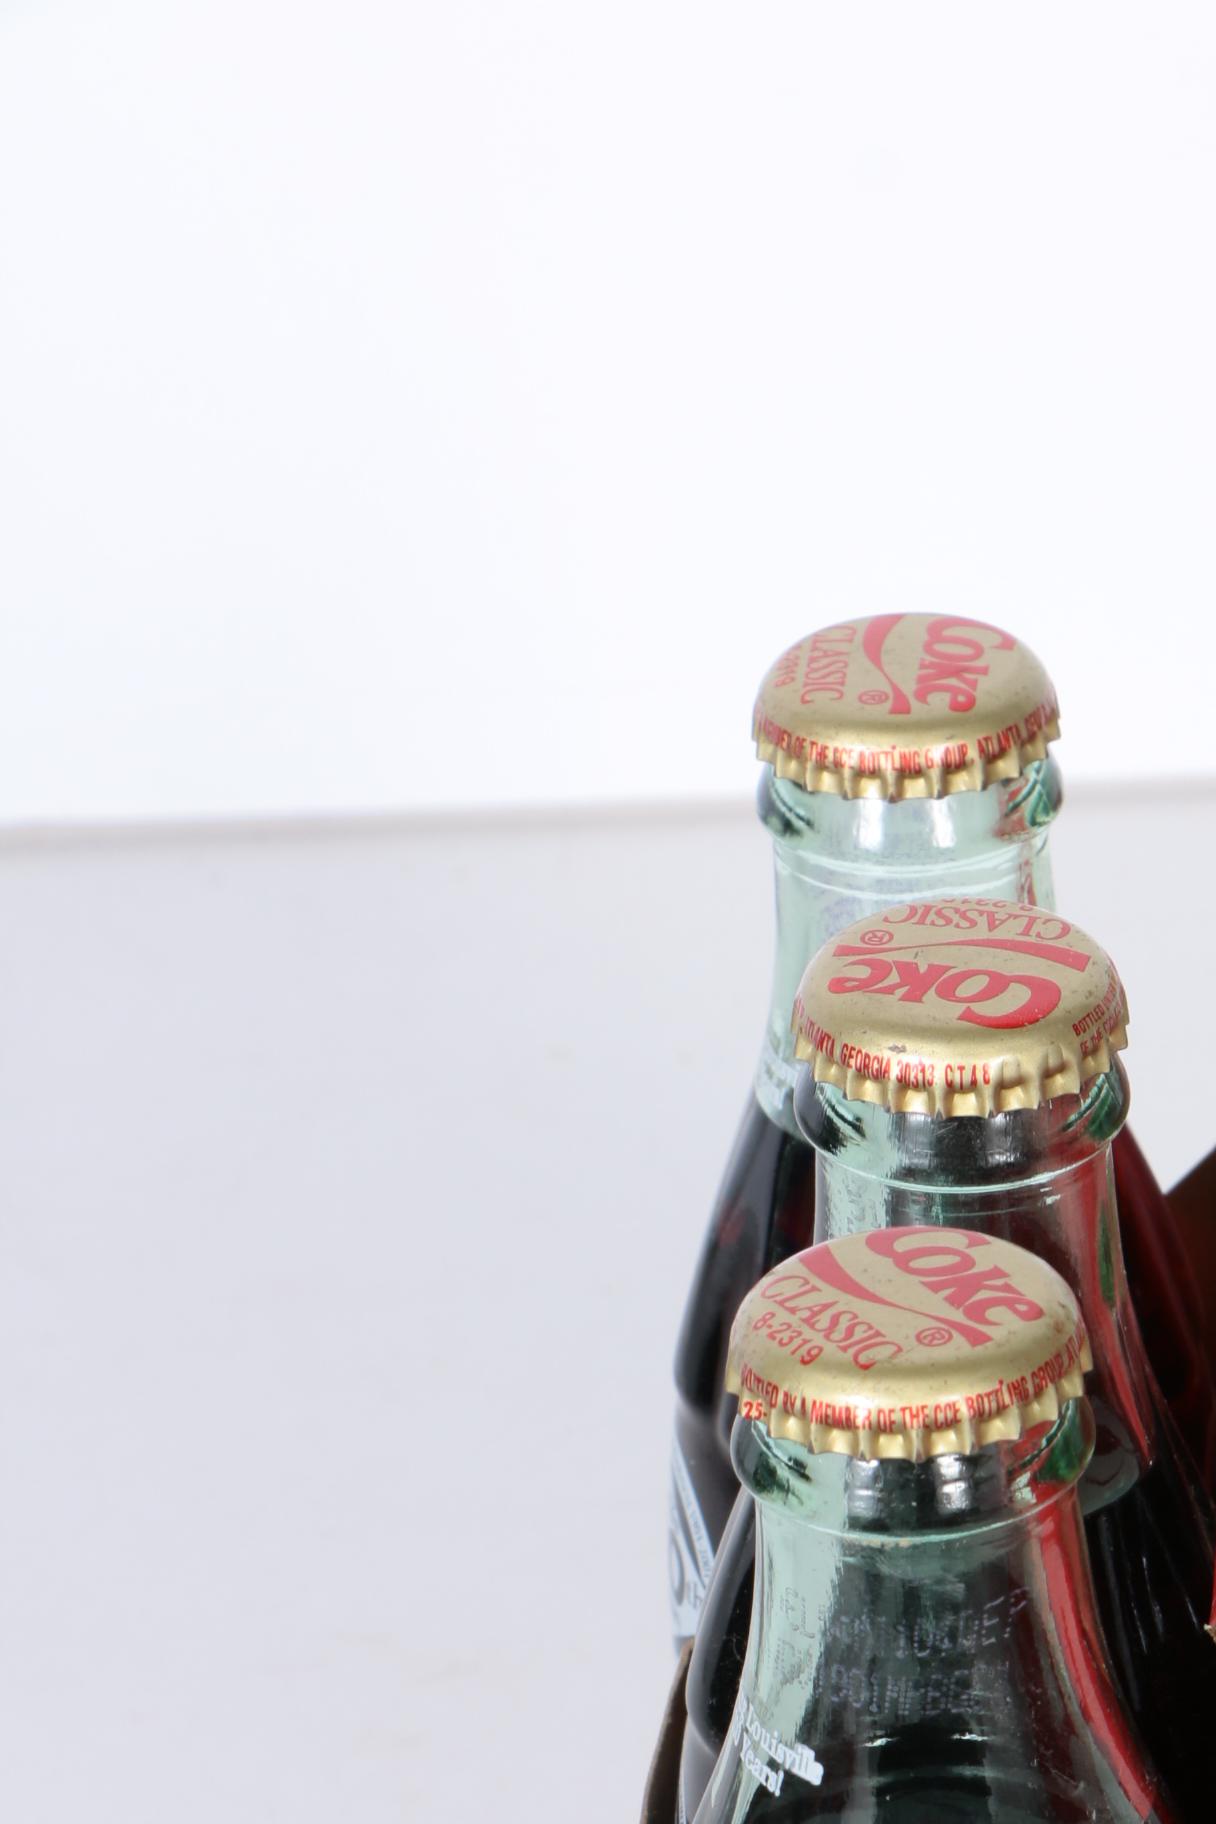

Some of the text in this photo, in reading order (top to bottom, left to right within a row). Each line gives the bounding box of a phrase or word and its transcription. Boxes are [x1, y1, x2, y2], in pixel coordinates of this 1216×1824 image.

[800, 623, 856, 705] CLASSIC
[914, 616, 1017, 713] Coke
[883, 903, 1072, 941] CLASSIC
[828, 957, 1062, 1030] Coke
[841, 1042, 892, 1082] GEORGIA
[896, 1058, 936, 1090] 30313
[865, 1226, 1044, 1326] Coke
[752, 1311, 824, 1366] 8-2319
[761, 1275, 903, 1370] CLASSIC
[810, 1399, 873, 1431] MEMBER
[876, 1407, 896, 1433] OF
[900, 1404, 930, 1430] THE
[933, 1402, 962, 1430] CCE
[964, 1375, 1031, 1421] BOTTLING
